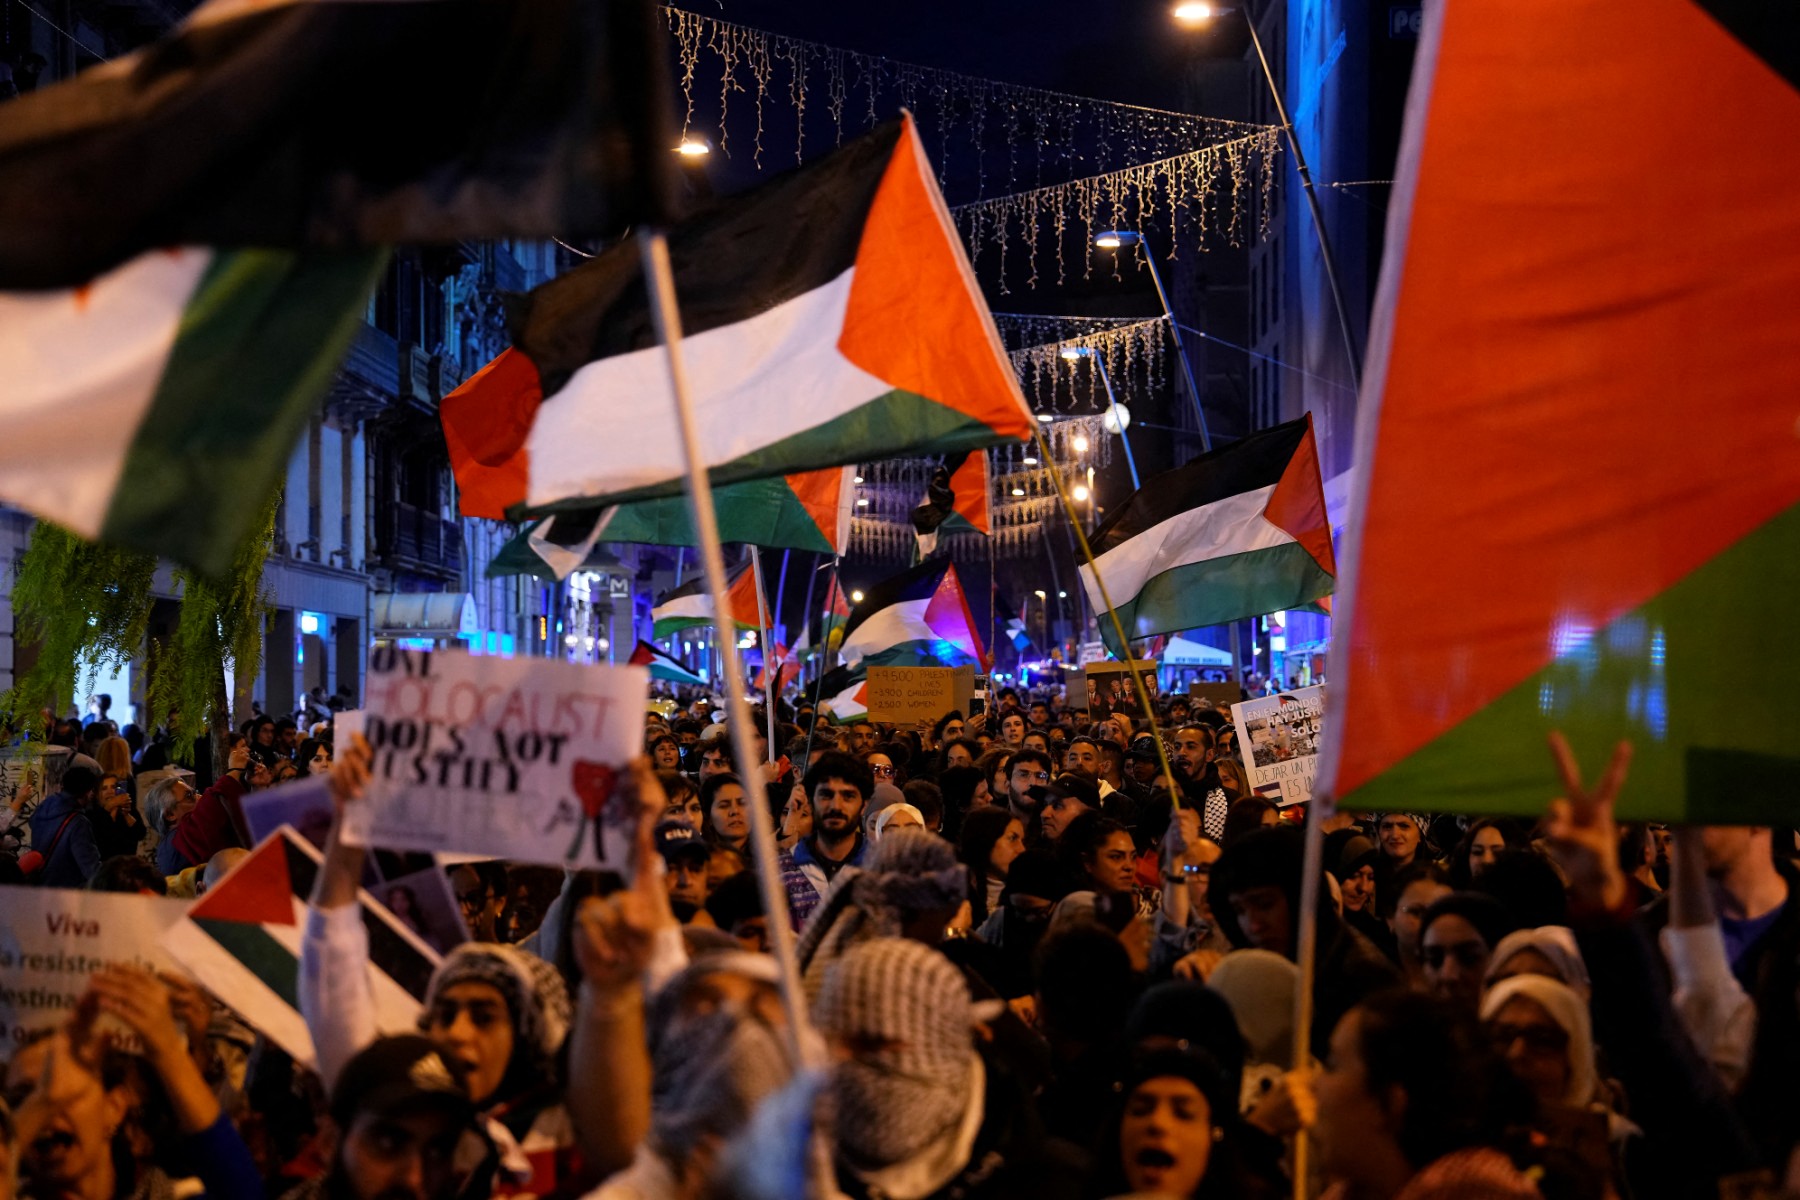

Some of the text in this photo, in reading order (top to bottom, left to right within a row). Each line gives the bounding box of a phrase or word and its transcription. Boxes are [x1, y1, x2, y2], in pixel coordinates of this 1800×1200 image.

[907, 689, 944, 697] CHILDREN
[919, 680, 941, 688] LIVES
[366, 676, 613, 740] HOLOCAUST
[907, 701, 936, 709] WOMEN
[1247, 696, 1319, 721] EN EL MUNDO
[1267, 713, 1290, 727] HAY
[494, 728, 568, 767] NOT
[1255, 764, 1288, 784] DEJAR
[1291, 761, 1304, 776] UN
[1286, 780, 1300, 798] ES
[46, 913, 99, 937] Viva
[20, 951, 156, 973] resisteia
